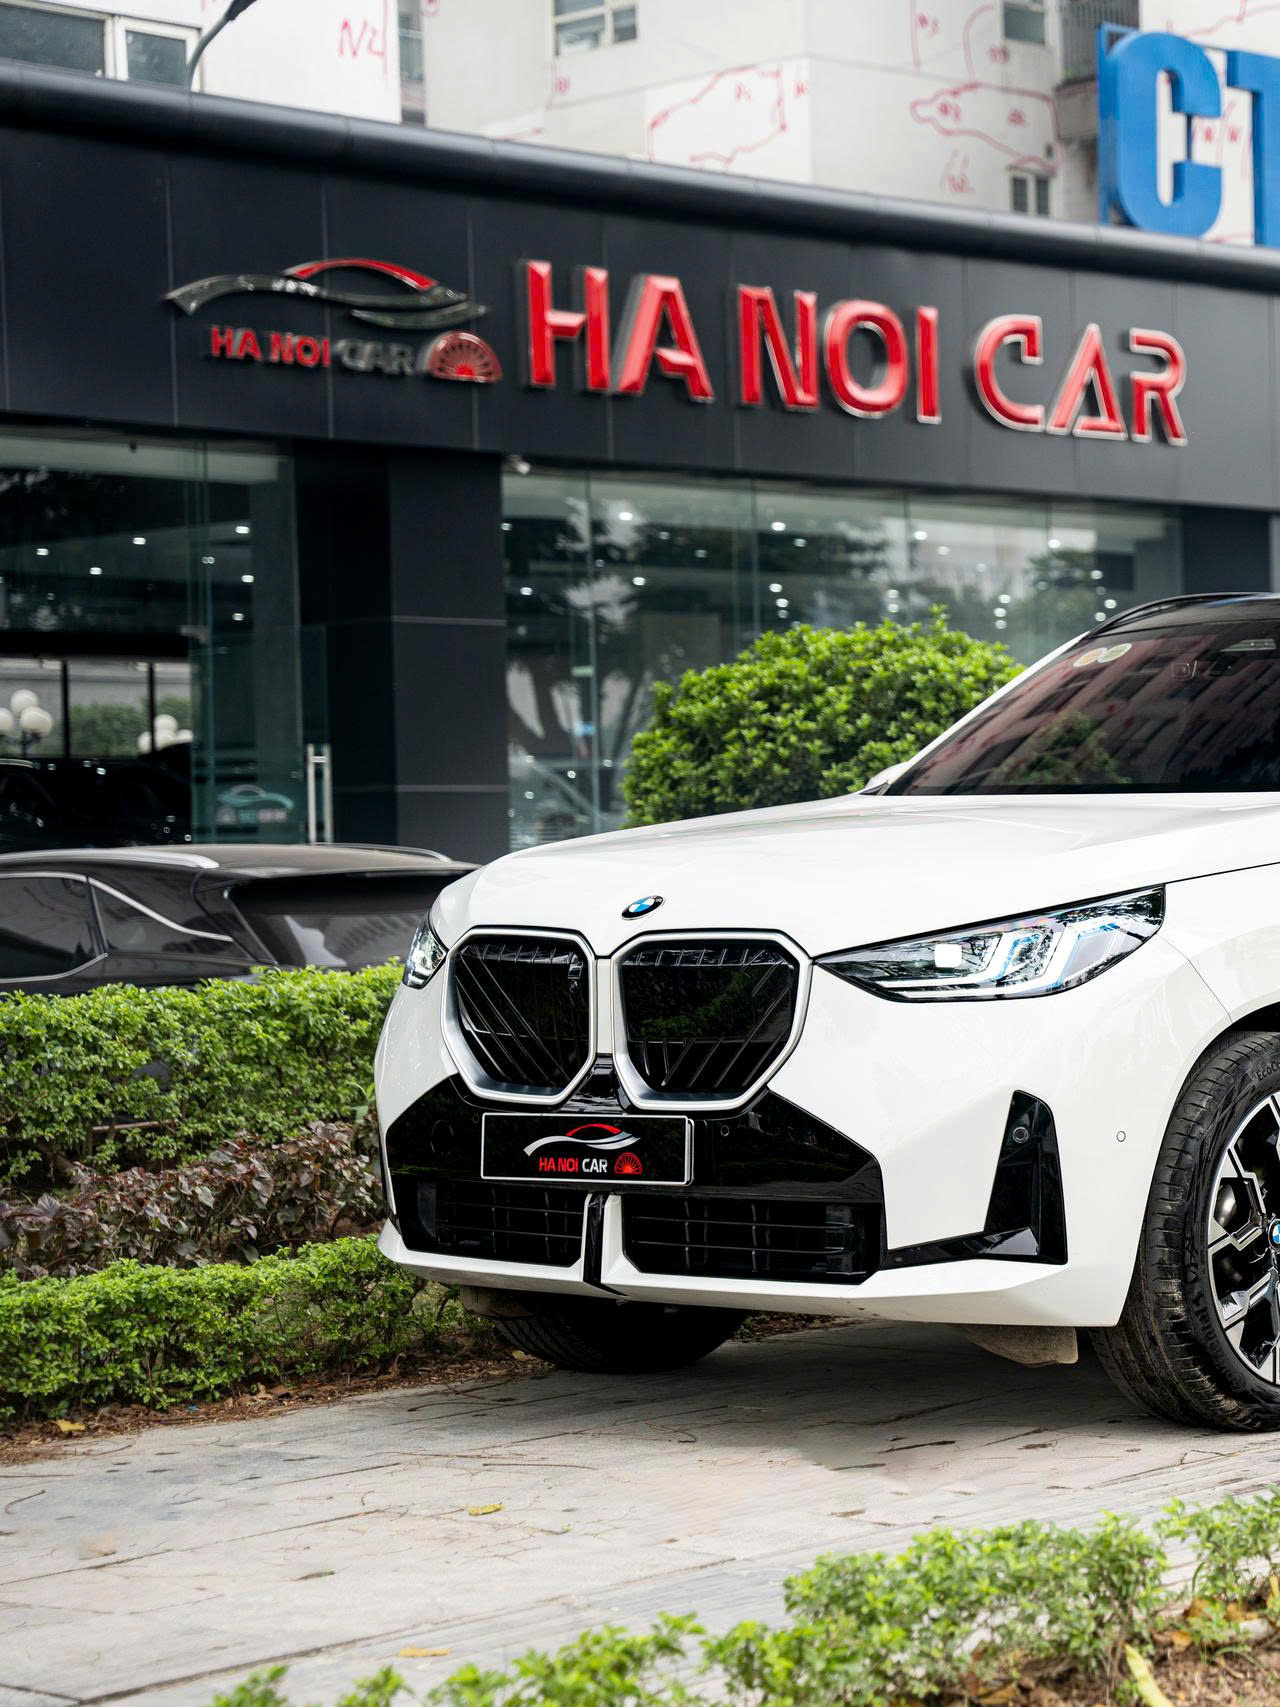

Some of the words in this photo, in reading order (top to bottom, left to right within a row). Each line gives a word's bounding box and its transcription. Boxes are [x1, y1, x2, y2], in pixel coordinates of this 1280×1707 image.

[211, 325, 262, 361] HA
[269, 331, 331, 368] NOI
[334, 338, 414, 376] CAR
[522, 259, 716, 402] HA
[738, 284, 943, 425] NOI
[973, 313, 1188, 446] CAR
[538, 1157, 556, 1172] HA
[558, 1157, 579, 1172] NOI
[581, 1158, 608, 1173] CAR
